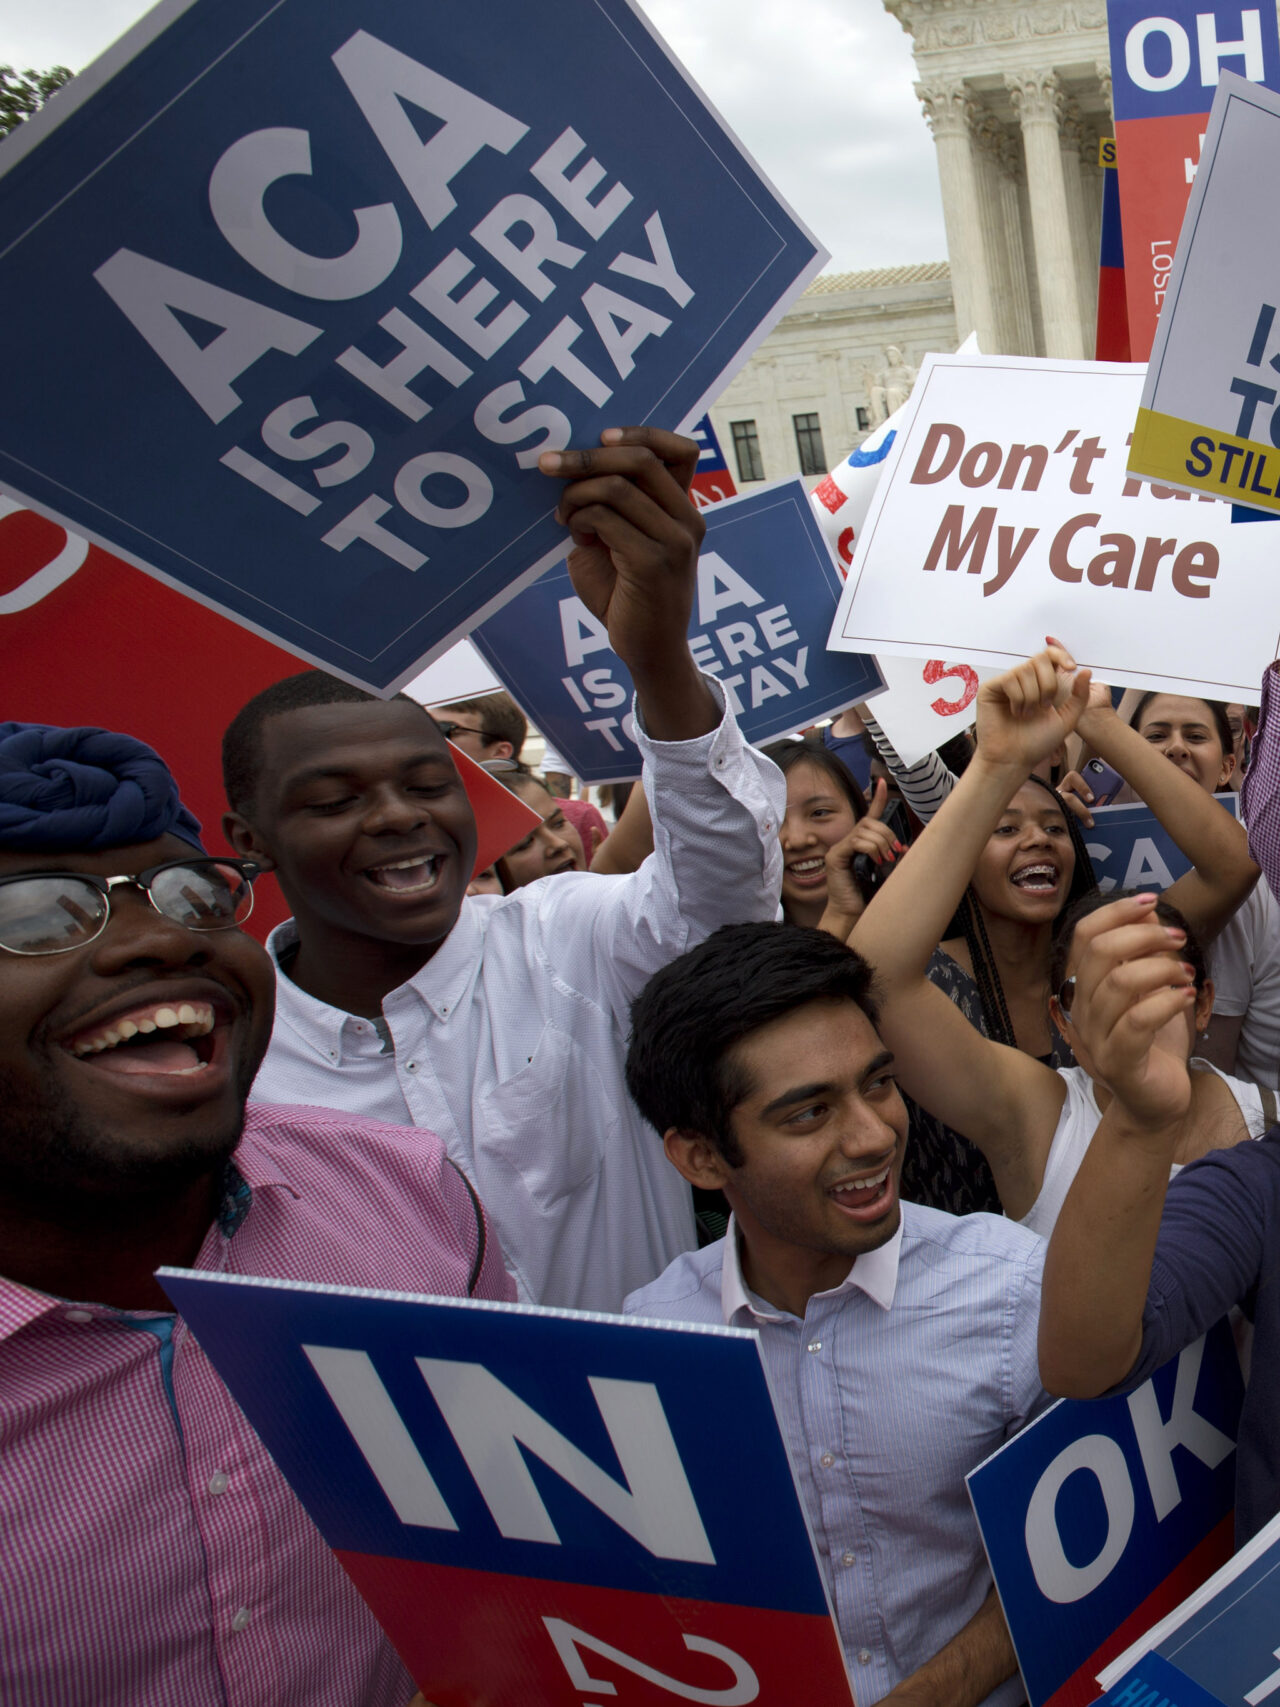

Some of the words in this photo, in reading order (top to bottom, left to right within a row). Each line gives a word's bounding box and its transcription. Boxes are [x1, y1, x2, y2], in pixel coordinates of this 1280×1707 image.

[1125, 9, 1266, 93] OH
[92, 28, 531, 425] ACA
[219, 395, 375, 518] IS
[335, 125, 634, 423] HERE
[320, 451, 494, 573] TO
[473, 210, 696, 470] STAY
[558, 551, 766, 668] AA
[923, 504, 1040, 598] My
[1048, 512, 1221, 600] Care
[561, 668, 628, 714] IS
[687, 603, 800, 676] ERE
[584, 712, 638, 751] T
[722, 645, 810, 717] TAY
[302, 1343, 717, 1565] IN
[1024, 1335, 1237, 1605] OK
[541, 1616, 760, 1707] 2
